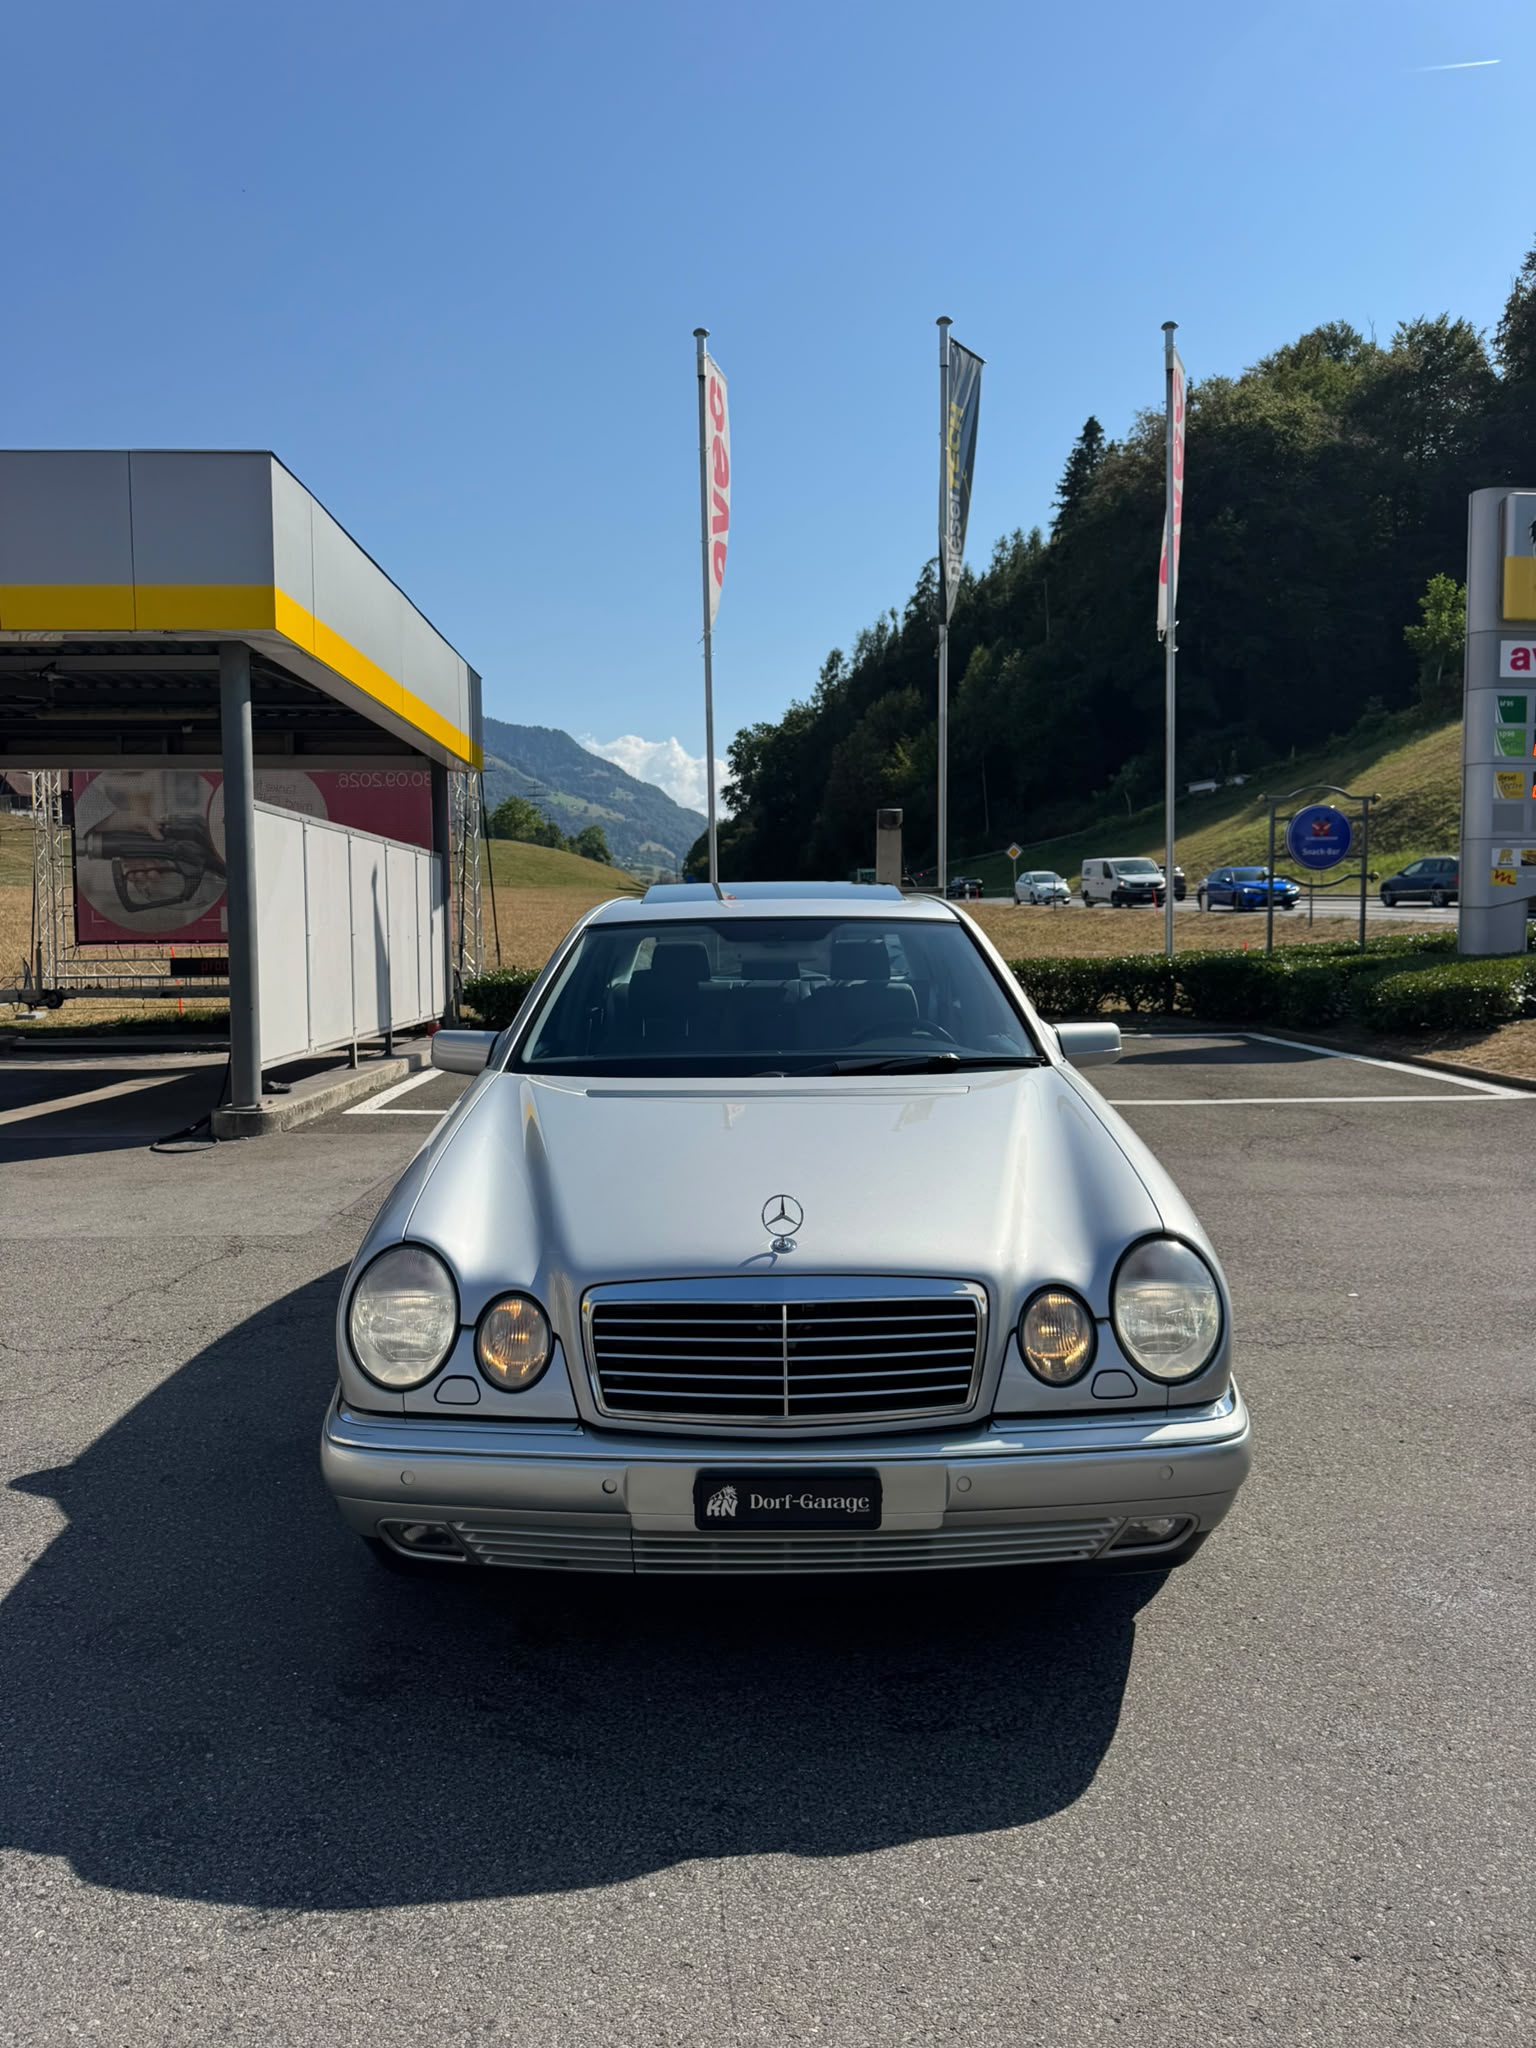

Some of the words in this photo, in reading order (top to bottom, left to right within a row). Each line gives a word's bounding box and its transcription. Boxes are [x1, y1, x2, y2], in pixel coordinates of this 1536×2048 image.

[709, 376, 730, 588] avec
[1510, 647, 1536, 671] a
[750, 1494, 870, 1513] Dorf-Garage
